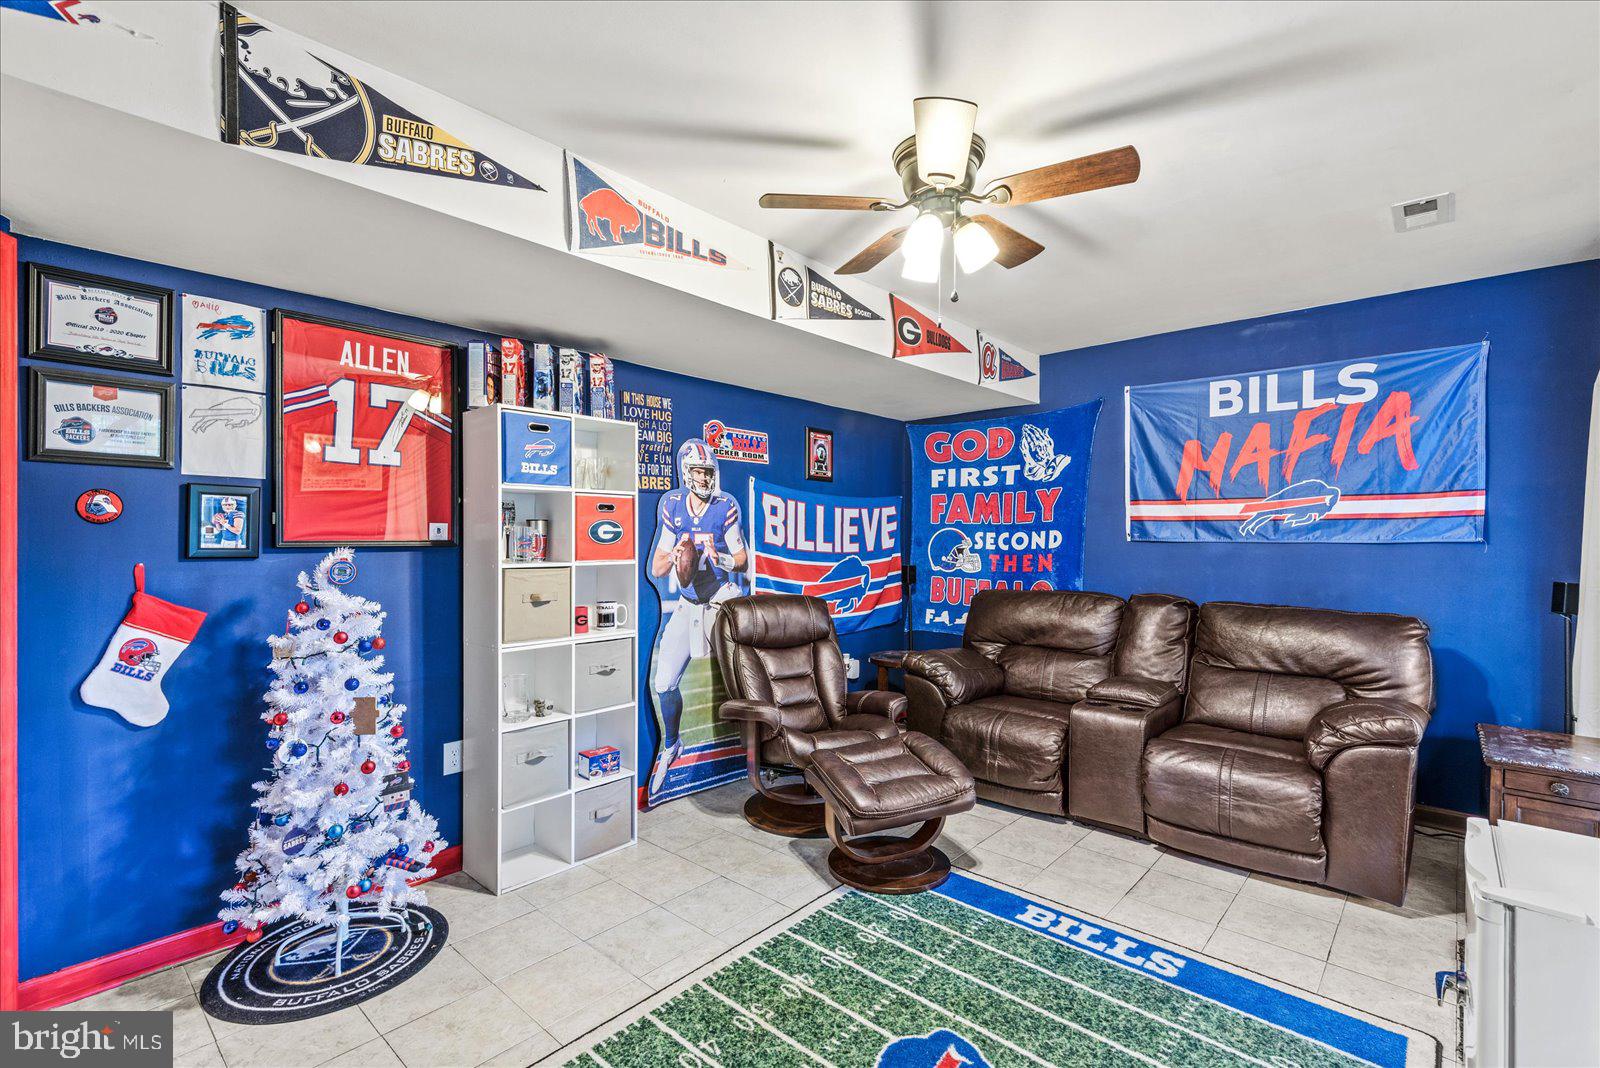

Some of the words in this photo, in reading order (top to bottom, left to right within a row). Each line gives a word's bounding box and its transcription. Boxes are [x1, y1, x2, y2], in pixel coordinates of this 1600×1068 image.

[386, 117, 434, 140] BUFFALO
[377, 132, 476, 177] SABRES
[638, 199, 669, 223] BUFFALO
[643, 212, 727, 266] BILLS
[810, 280, 842, 300] BUFFALO
[80, 294, 111, 304] Backers
[113, 300, 154, 317] Association
[810, 291, 853, 319] SABRES
[65, 321, 88, 330] Official
[125, 330, 147, 340] Chapter
[897, 316, 922, 346] G
[926, 329, 951, 350] BULLDOGS
[340, 340, 410, 375] ALLEN
[193, 359, 256, 381] BILLS
[503, 362, 516, 375] 17
[561, 368, 572, 379] 17
[591, 376, 603, 388] 17
[1209, 362, 1379, 418] BILLS
[623, 391, 630, 404] IN
[631, 392, 645, 406] THIS
[645, 395, 662, 409] HOUSE
[662, 397, 672, 410] WE
[54, 403, 75, 413] BILLS
[76, 403, 111, 413] BACKERS
[111, 406, 154, 421] ASSOCIATION
[323, 377, 419, 467] 17
[623, 405, 650, 420] LOVE
[651, 410, 672, 422] HUG
[638, 430, 655, 441] EAM
[656, 431, 672, 443] BIG
[651, 421, 657, 430] A
[658, 421, 672, 431] LOT
[640, 442, 672, 454] grateful
[713, 448, 739, 457] OCKER
[742, 451, 765, 460] ROOM
[924, 427, 1016, 463] GOD
[1175, 391, 1420, 505] MAFIA
[521, 461, 558, 475] BILLS
[638, 453, 649, 463] VE
[653, 453, 672, 464] FUN
[647, 463, 660, 476] FOR
[661, 465, 672, 476] THE
[930, 464, 1021, 489] FIRST
[638, 475, 671, 491] ABRES
[930, 486, 1063, 525] FAMILY
[762, 491, 898, 554] BILLIEVE
[973, 530, 1063, 551] SECOND
[989, 554, 1053, 573] THEN
[110, 662, 155, 681] BILLS
[1014, 904, 1187, 979] BILLS
[230, 933, 277, 981] NATIONAL
[376, 936, 425, 979] SABRES
[272, 978, 370, 1007] BUFFALO
